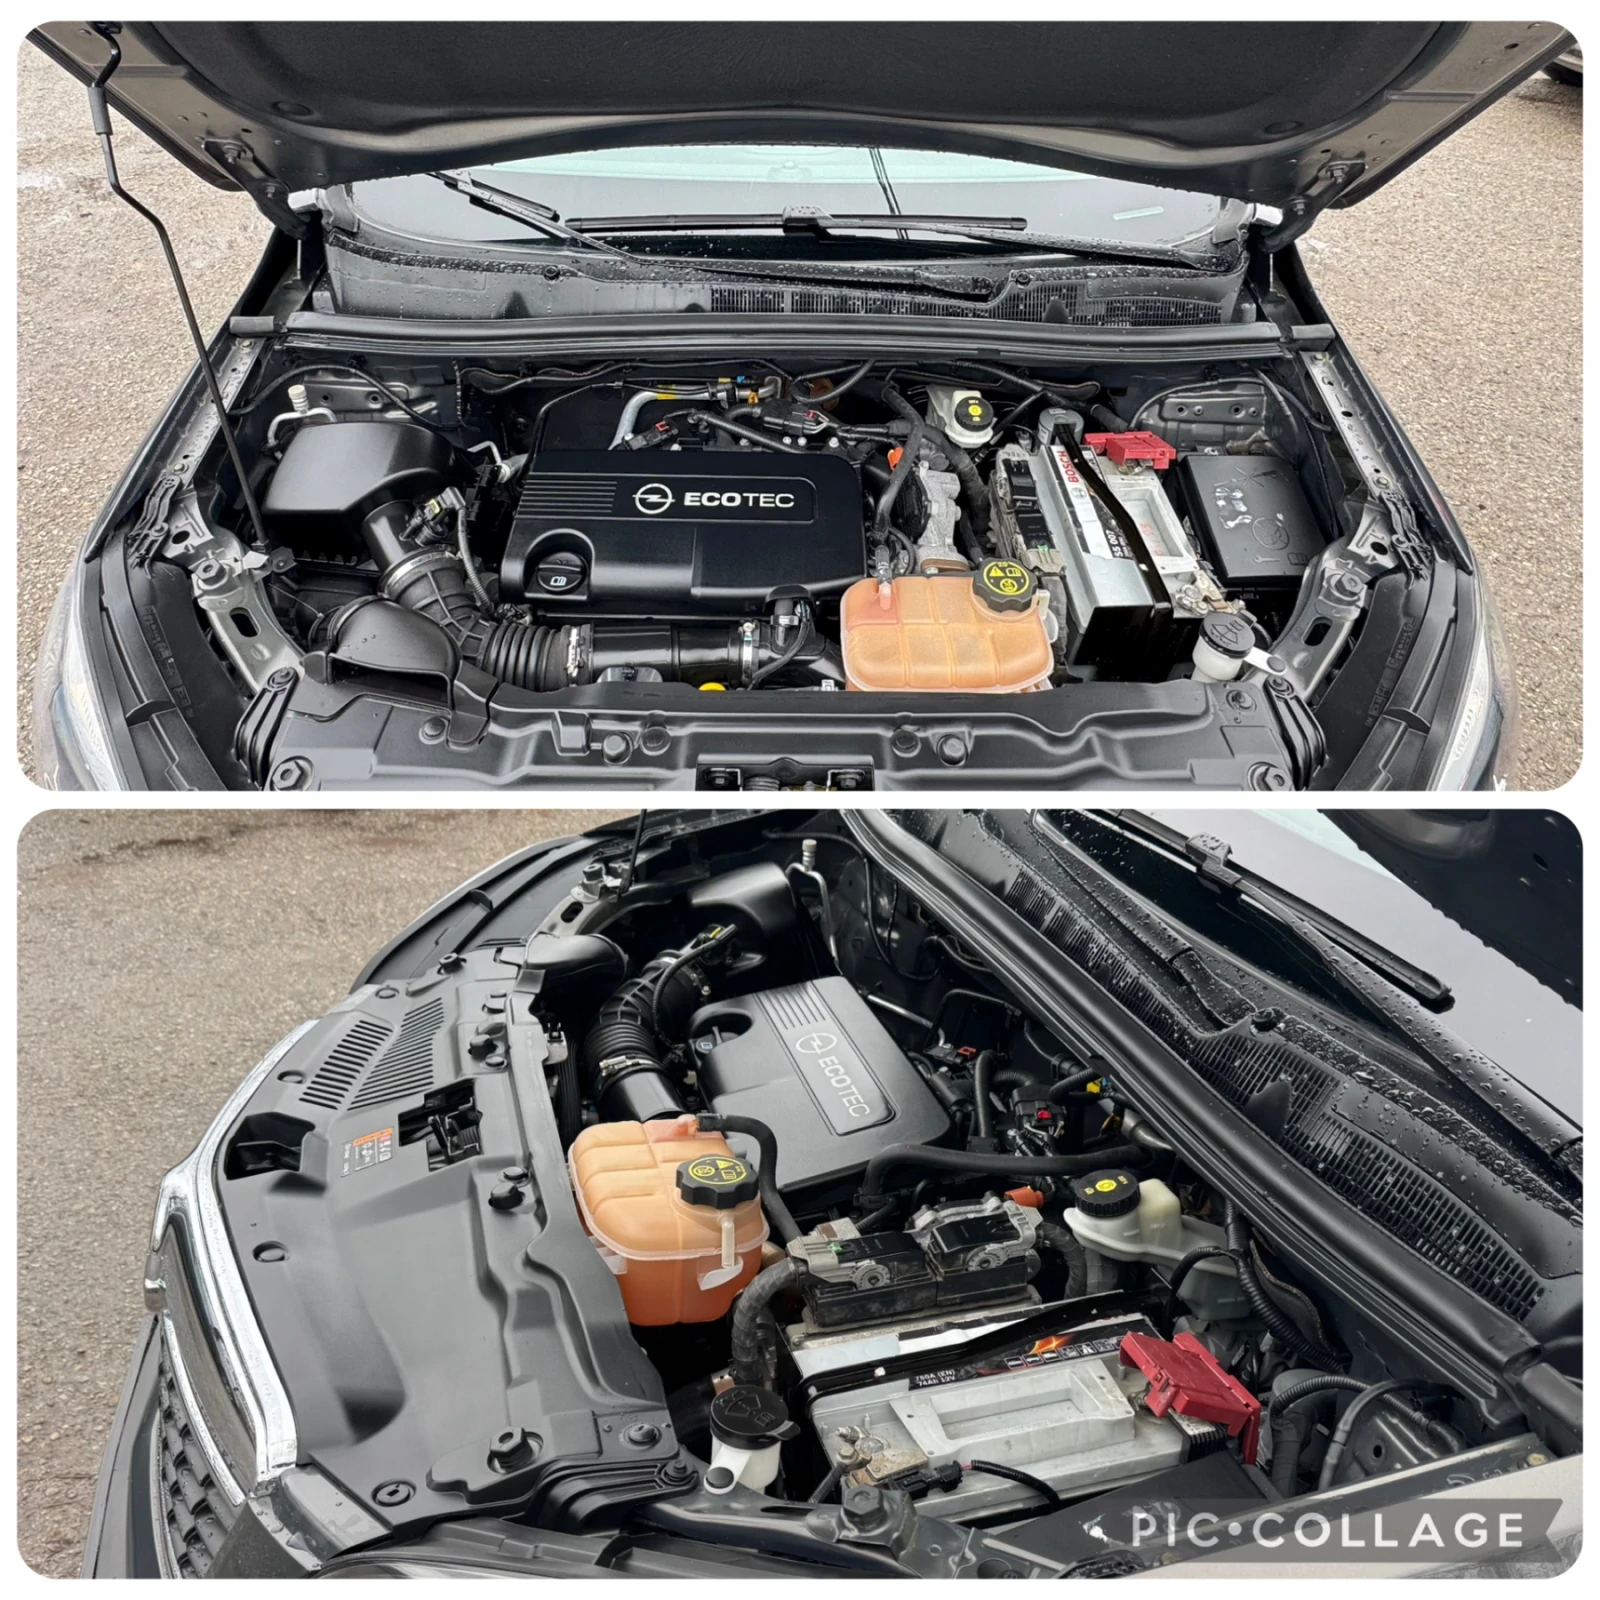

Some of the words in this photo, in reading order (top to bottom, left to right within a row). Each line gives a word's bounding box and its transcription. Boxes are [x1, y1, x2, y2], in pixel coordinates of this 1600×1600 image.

[1057, 450, 1079, 483] BOSCH
[684, 491, 795, 508] ECOTEC
[1105, 530, 1119, 545] 007
[1112, 546, 1124, 557] S5
[818, 1055, 871, 1117] ECOTEC
